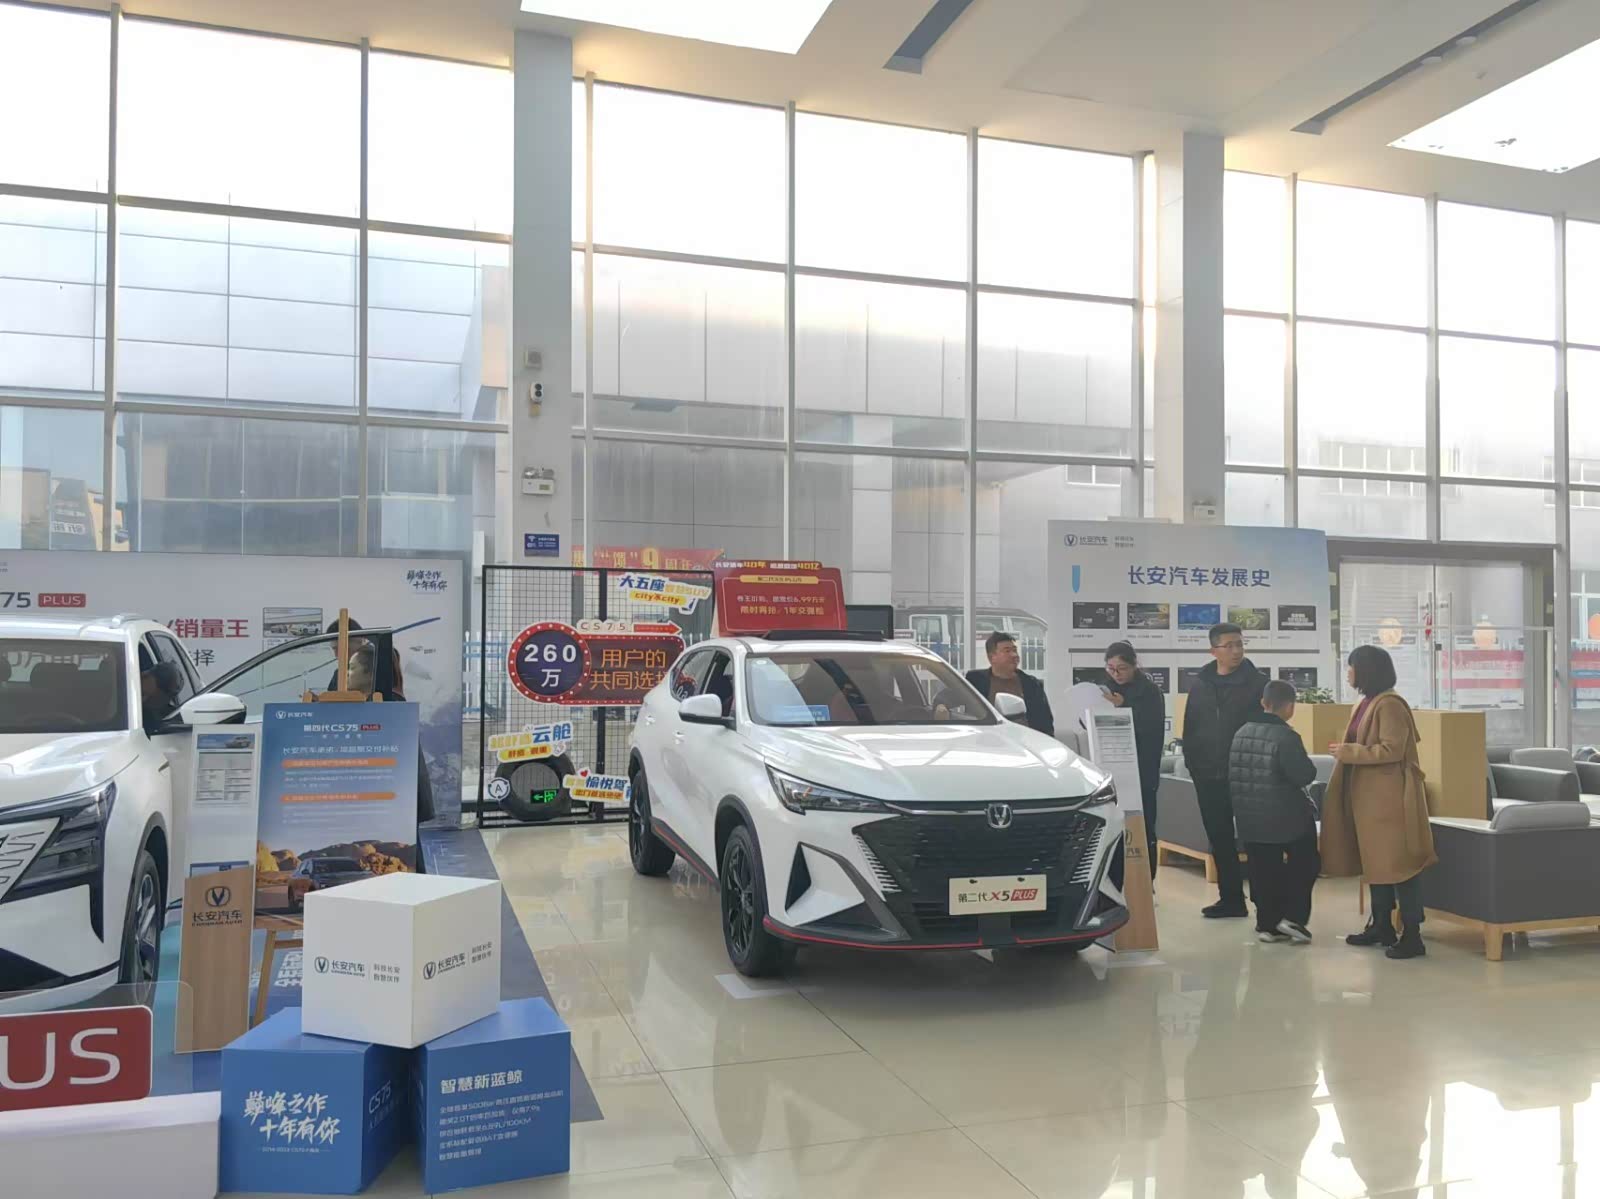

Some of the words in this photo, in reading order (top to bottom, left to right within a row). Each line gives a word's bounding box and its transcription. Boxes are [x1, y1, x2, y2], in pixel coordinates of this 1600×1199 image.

[1128, 565, 1271, 587] 长安汽车发展史
[43, 595, 82, 606] PLUS
[524, 644, 577, 662] 260
[601, 649, 666, 669] 用户的
[541, 668, 562, 688] 万
[958, 890, 1010, 903] 第二代X5
[1013, 888, 1035, 900] PLUS
[192, 910, 243, 922] 长安汽车
[331, 959, 365, 972] 长安汽车
[438, 952, 465, 970] 长安汽车
[441, 1069, 523, 1094] 智慧新蓝鲸
[243, 1090, 329, 1126] 巅峰之作
[259, 1116, 341, 1145] 十年有你
